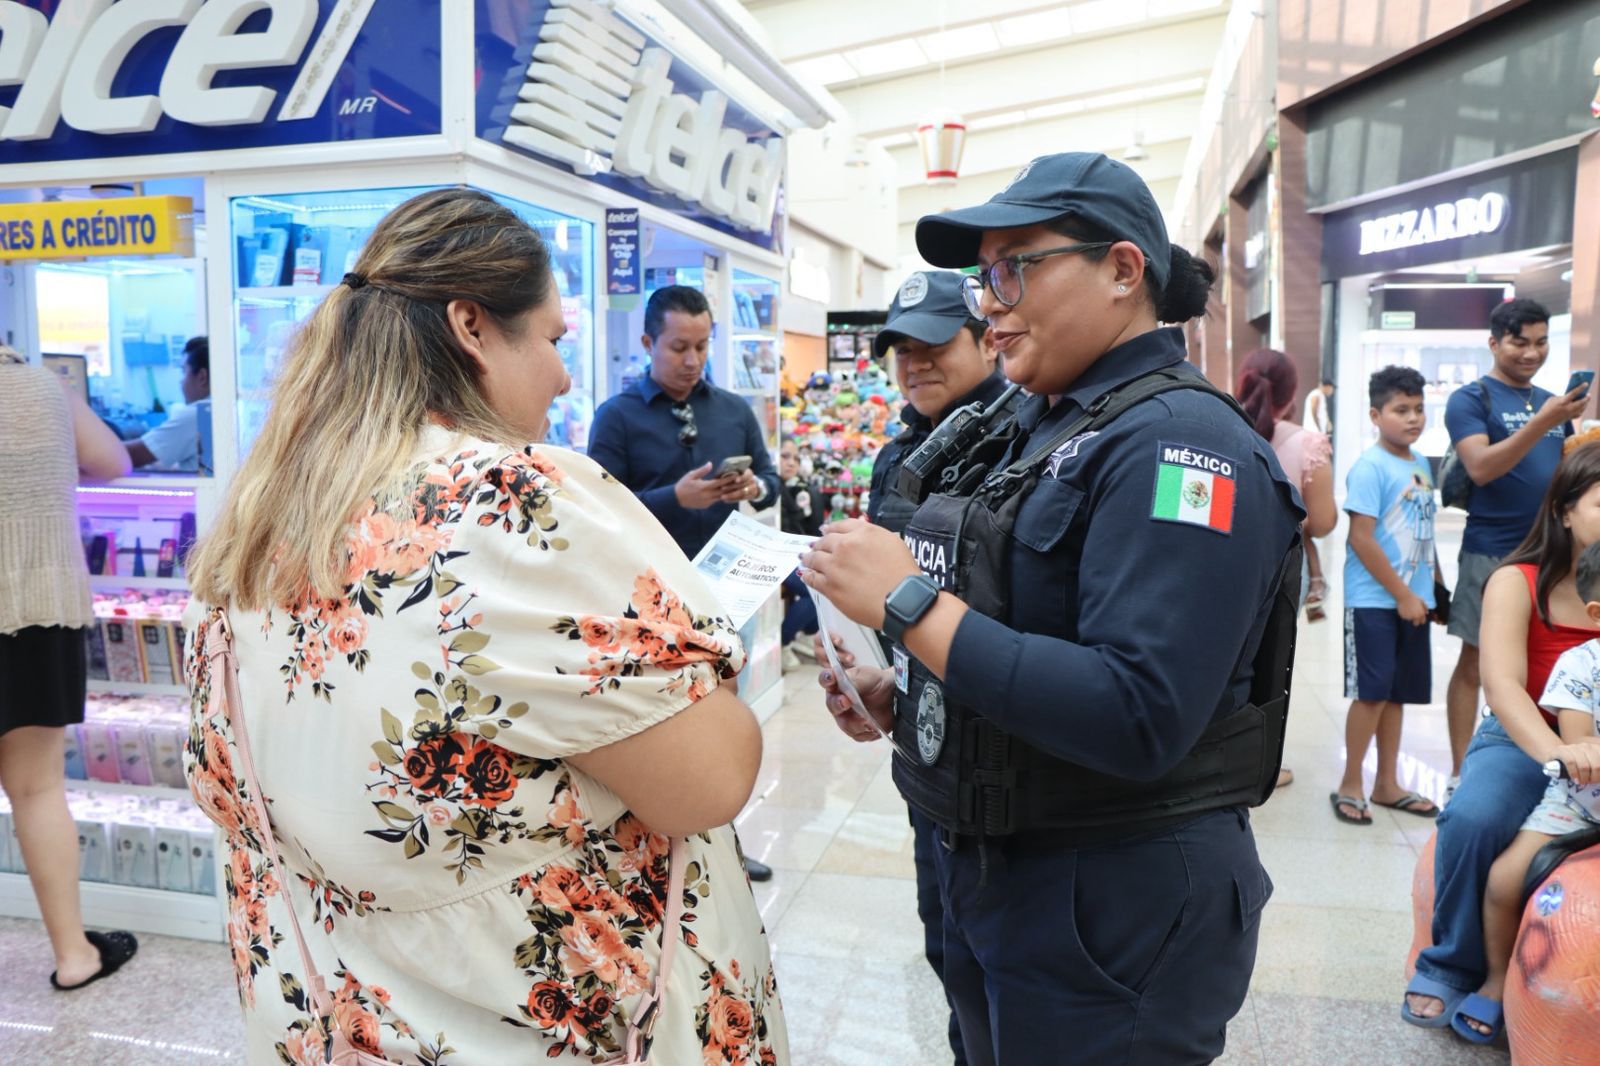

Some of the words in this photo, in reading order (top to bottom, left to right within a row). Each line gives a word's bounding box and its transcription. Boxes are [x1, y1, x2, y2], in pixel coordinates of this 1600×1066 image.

[339, 96, 377, 115] MR
[612, 47, 782, 234] telcel
[41, 220, 56, 248] A
[61, 209, 156, 248] CRÉDITO
[607, 212, 638, 223] telcel
[1359, 192, 1503, 255] BIZZARRO
[1164, 448, 1232, 476] MÉXICO
